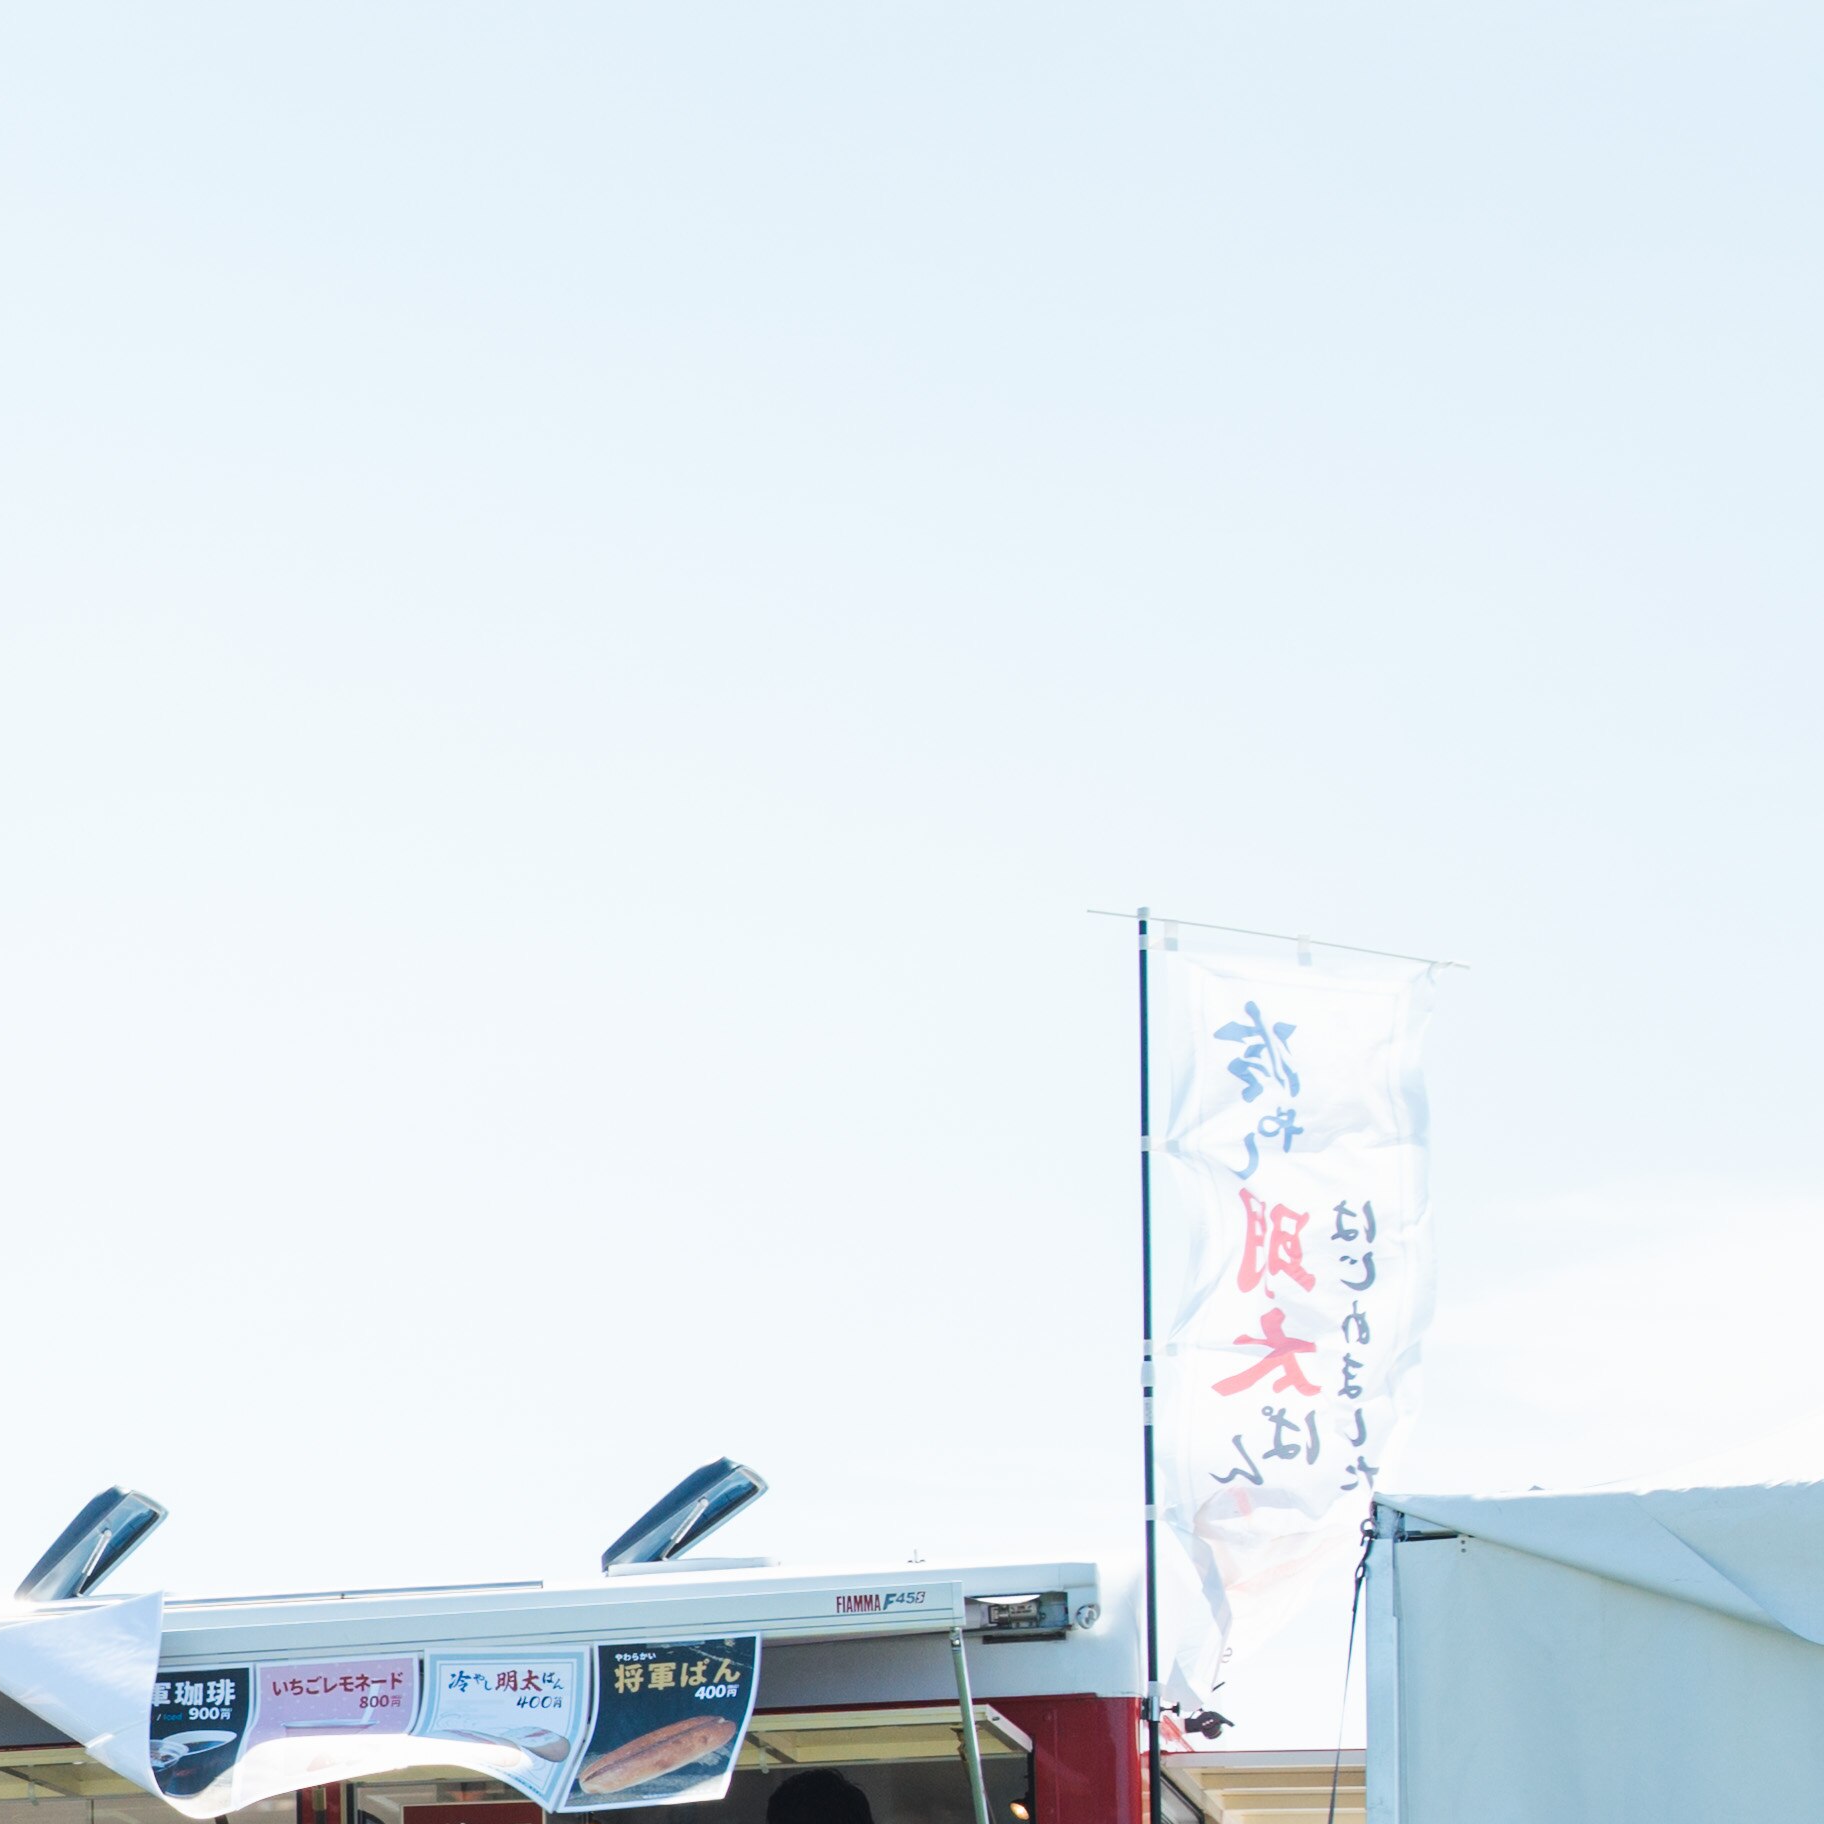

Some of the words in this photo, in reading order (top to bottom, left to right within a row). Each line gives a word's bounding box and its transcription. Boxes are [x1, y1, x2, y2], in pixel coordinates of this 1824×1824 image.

[836, 1594, 881, 1614] FIAMMA
[614, 1652, 657, 1662] やわらかい
[272, 1671, 404, 1696] いちごレモネード
[613, 1658, 741, 1694] 将軍ぱん
